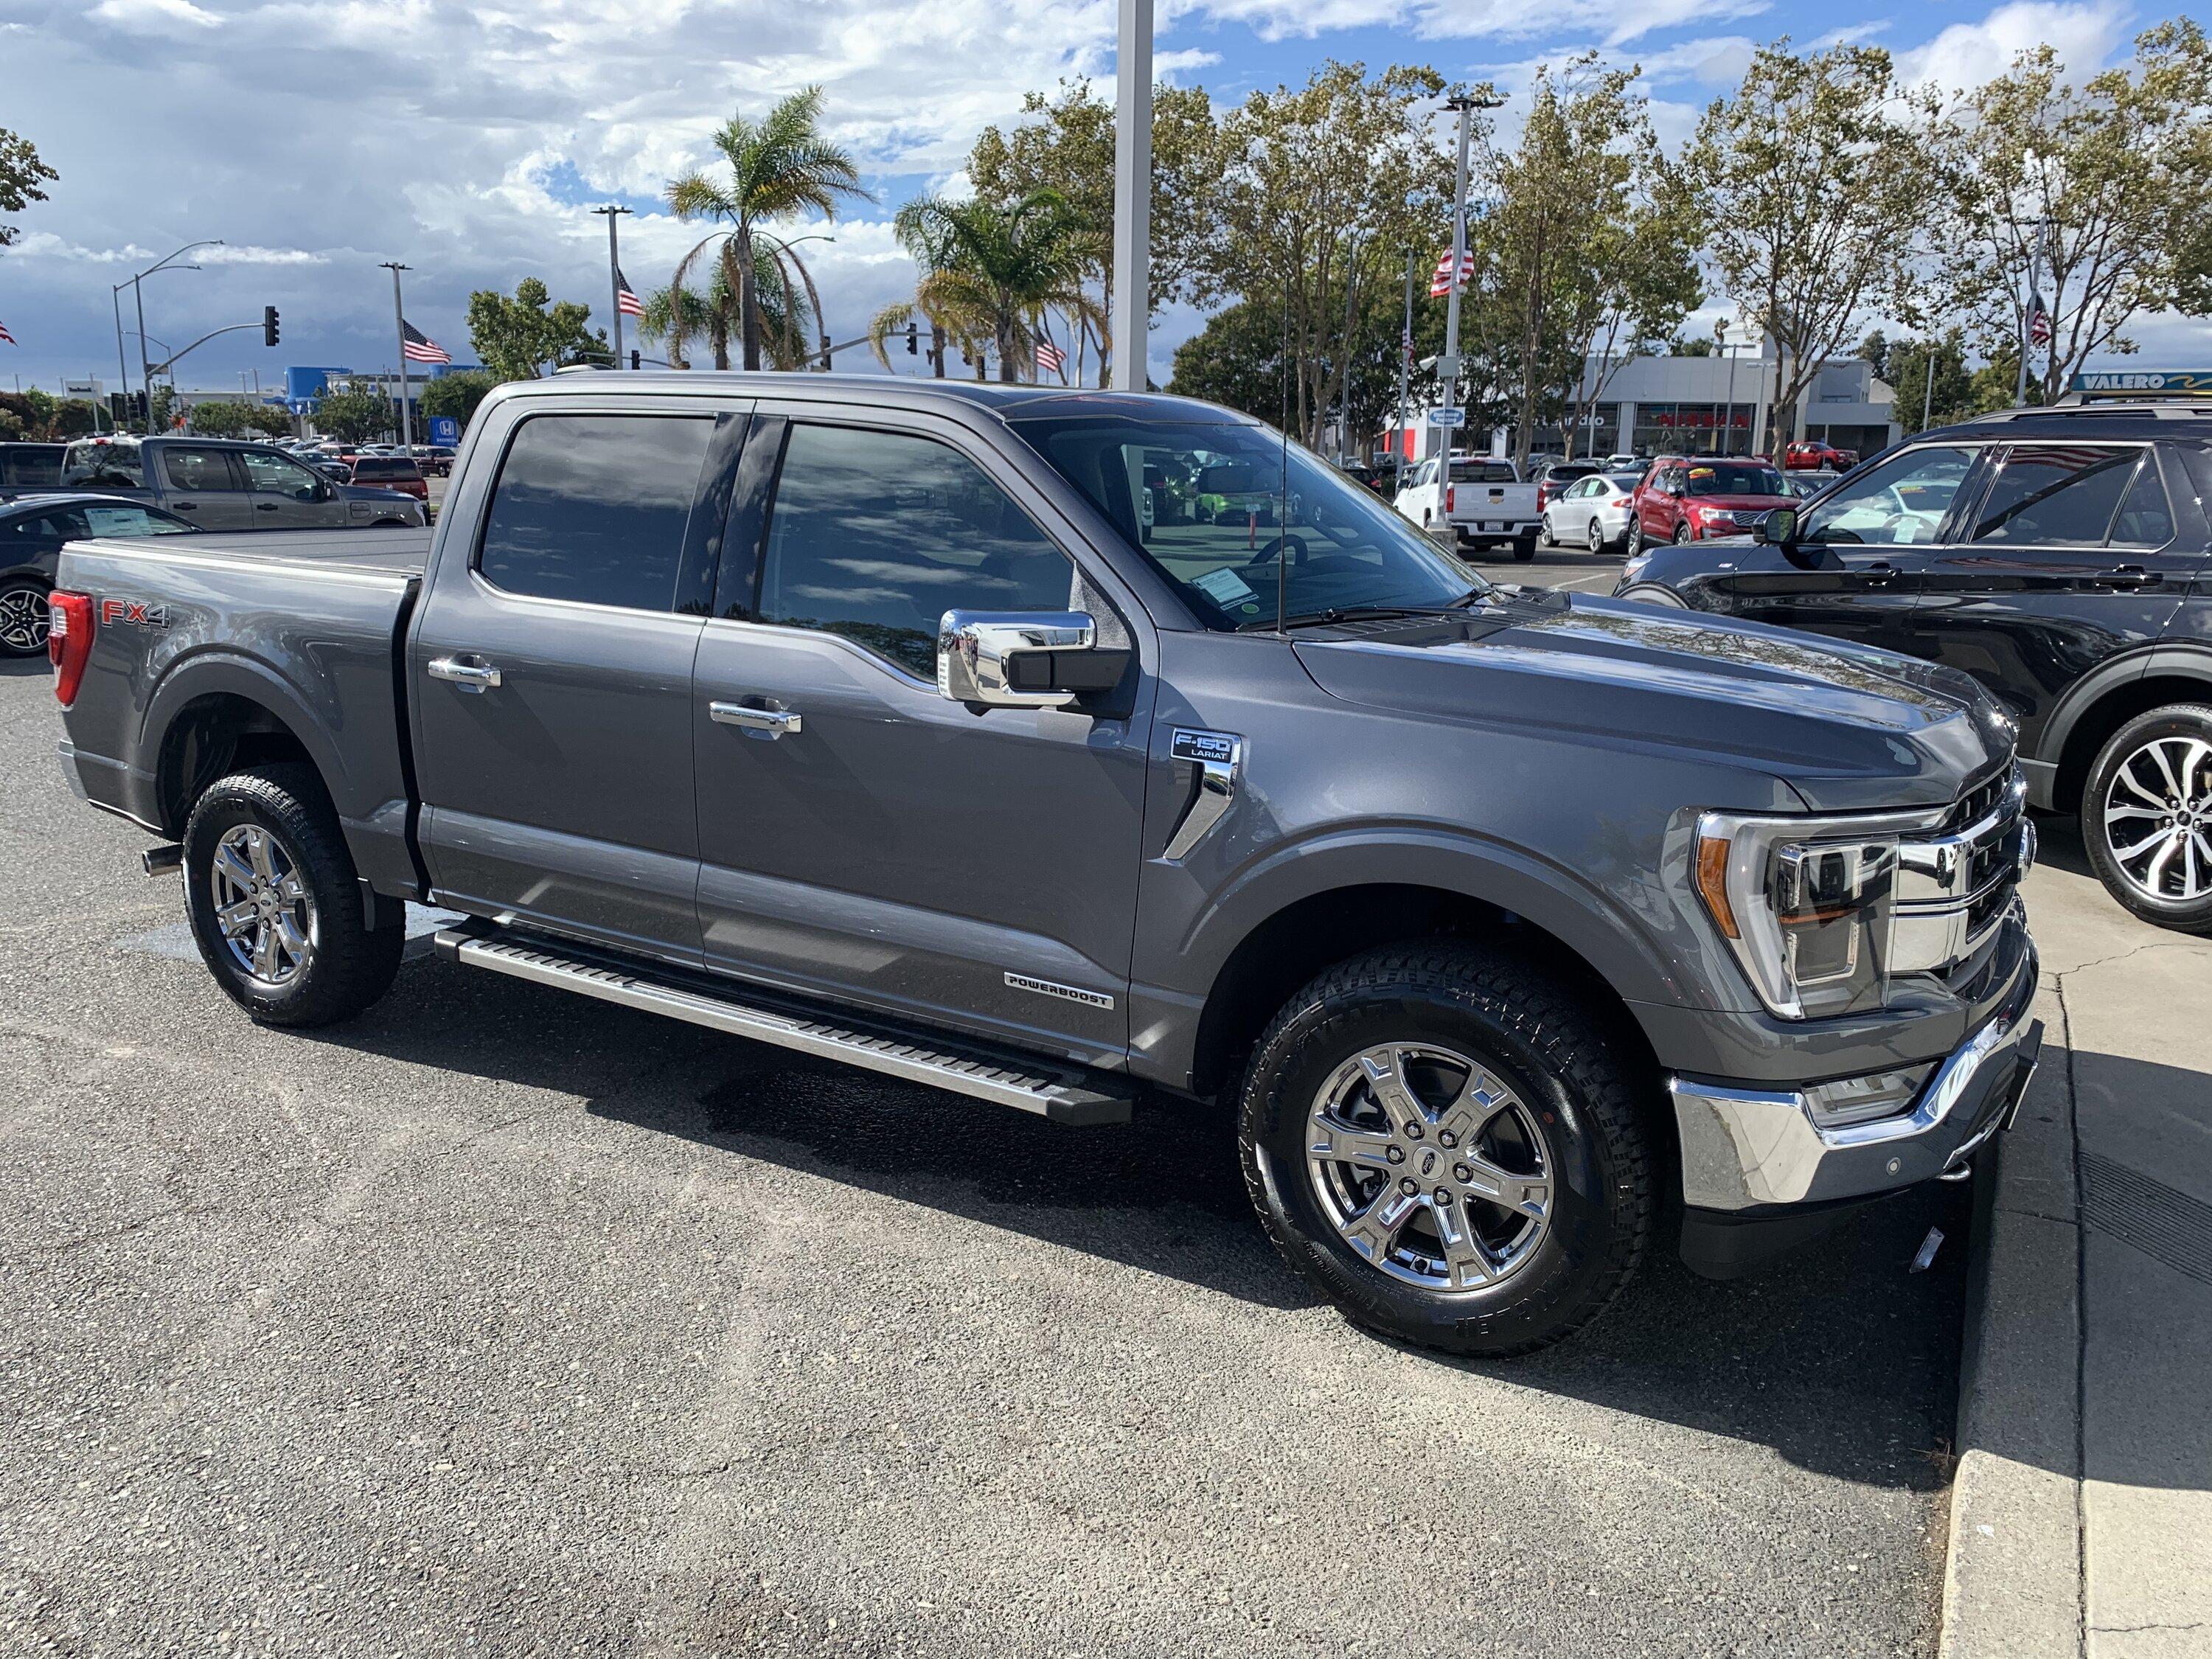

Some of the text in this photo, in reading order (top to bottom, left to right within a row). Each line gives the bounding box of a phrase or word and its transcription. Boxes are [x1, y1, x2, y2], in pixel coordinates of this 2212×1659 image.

[2083, 374, 2166, 389] VALERO
[1660, 412, 1750, 427] NISSAN
[102, 597, 171, 630] FX4
[1175, 734, 1231, 752] F-150
[1191, 748, 1228, 760] LARIAT
[1009, 975, 1108, 1006] POWERBOOST
[1422, 1155, 1435, 1172] Ford
